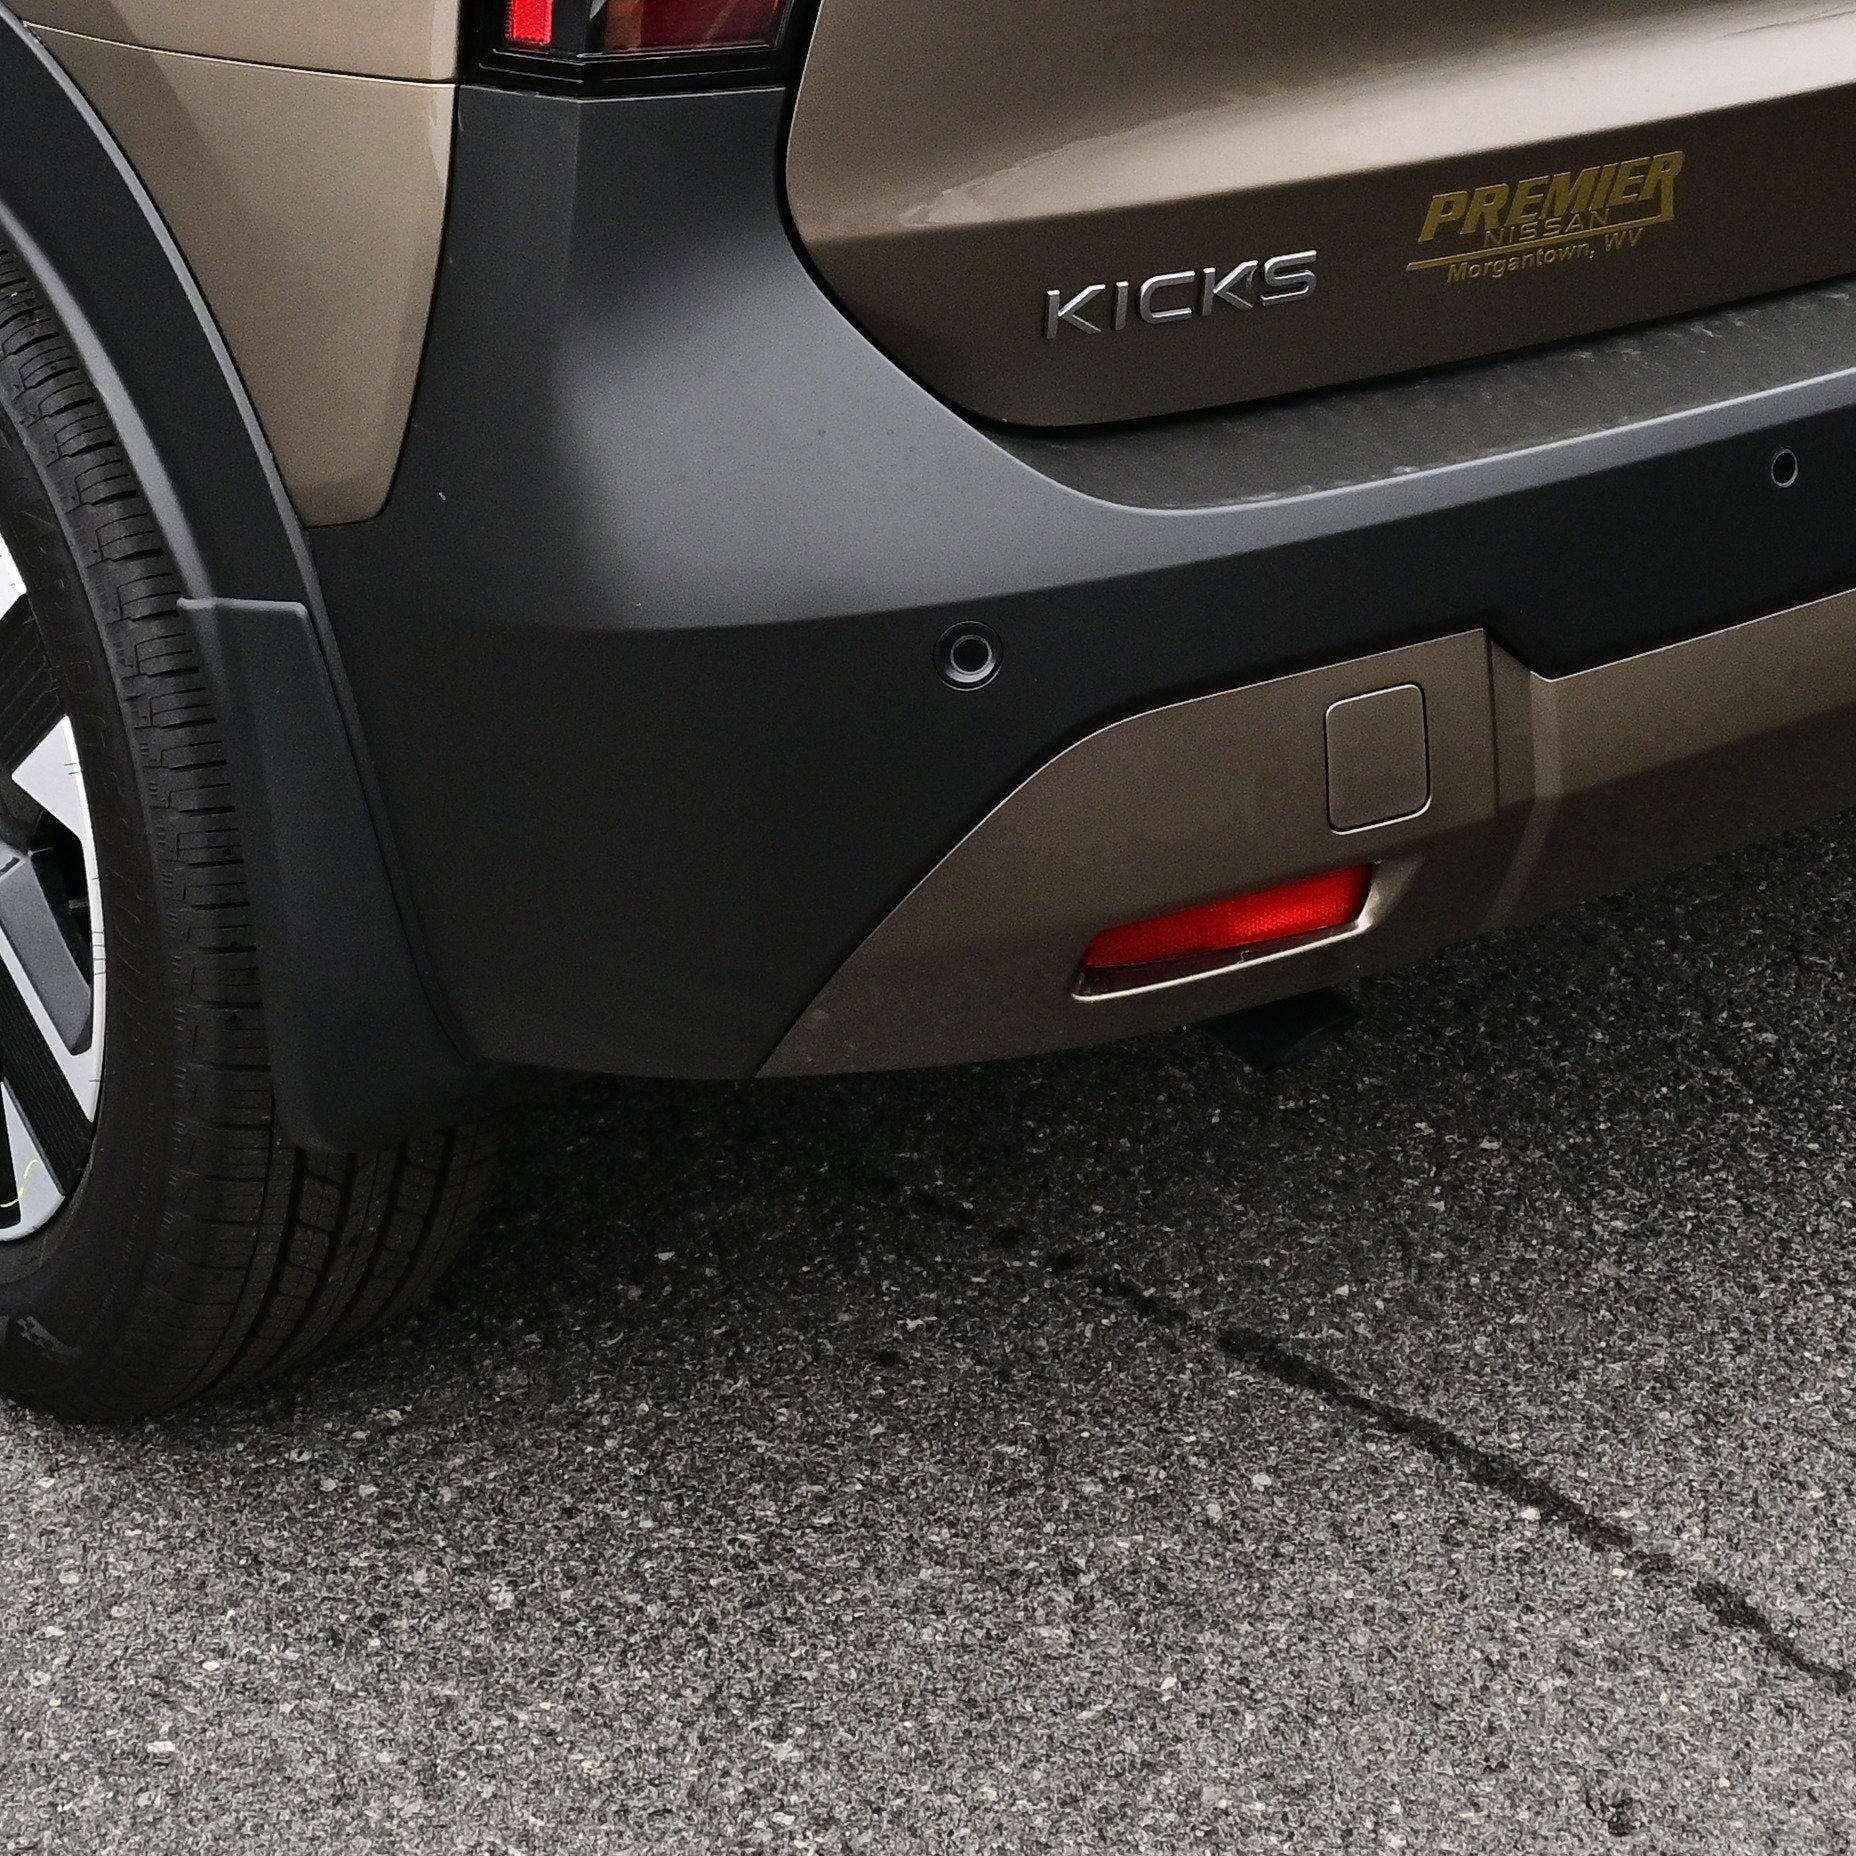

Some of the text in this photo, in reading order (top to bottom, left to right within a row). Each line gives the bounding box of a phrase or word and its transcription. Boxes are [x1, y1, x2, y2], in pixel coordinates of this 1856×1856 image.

[1418, 150, 1685, 243] PREMIER
[1483, 208, 1610, 248] NISSAN
[1447, 228, 1643, 284] Morgantown, WV
[1045, 250, 1318, 341] KICKS
